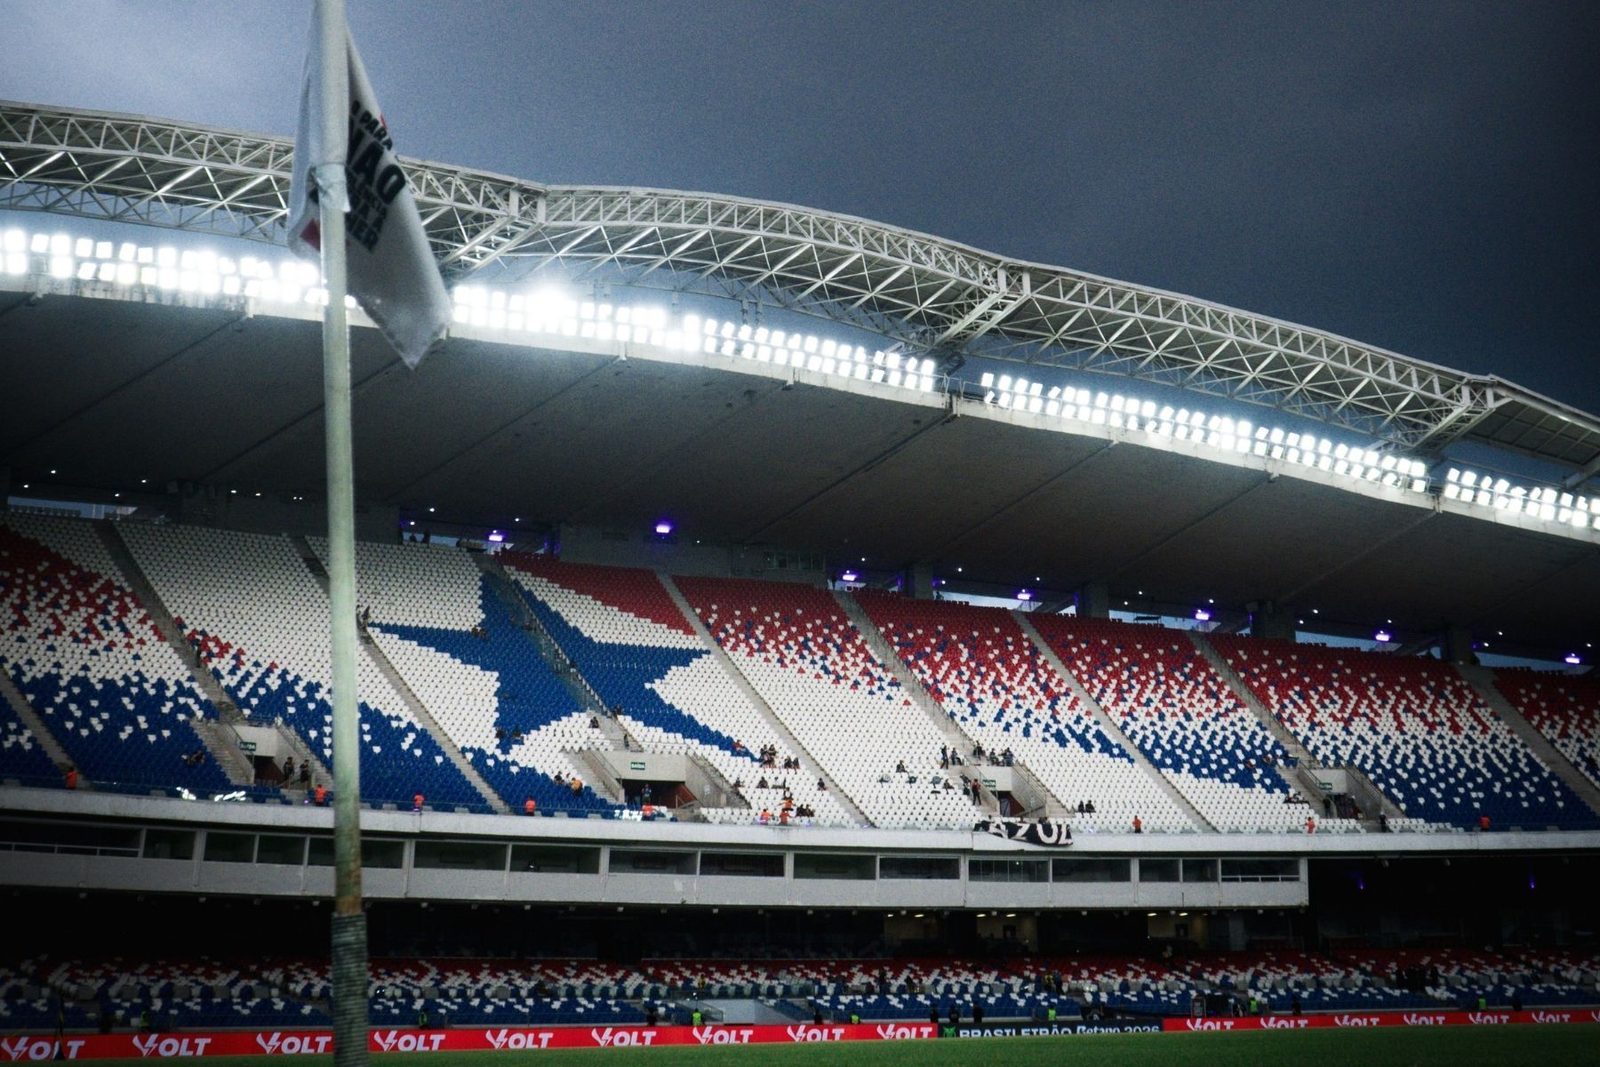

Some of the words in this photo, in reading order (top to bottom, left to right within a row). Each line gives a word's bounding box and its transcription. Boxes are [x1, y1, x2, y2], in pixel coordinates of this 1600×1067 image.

[374, 1030, 446, 1052] VOLT
[486, 1029, 554, 1049] VOLT
[591, 1027, 657, 1047] VOLT
[692, 1025, 754, 1045] VOLT
[786, 1024, 845, 1042] VOLT
[876, 1023, 933, 1040] VOLT
[132, 1034, 212, 1057] VOLT
[256, 1032, 332, 1055] VOLT
